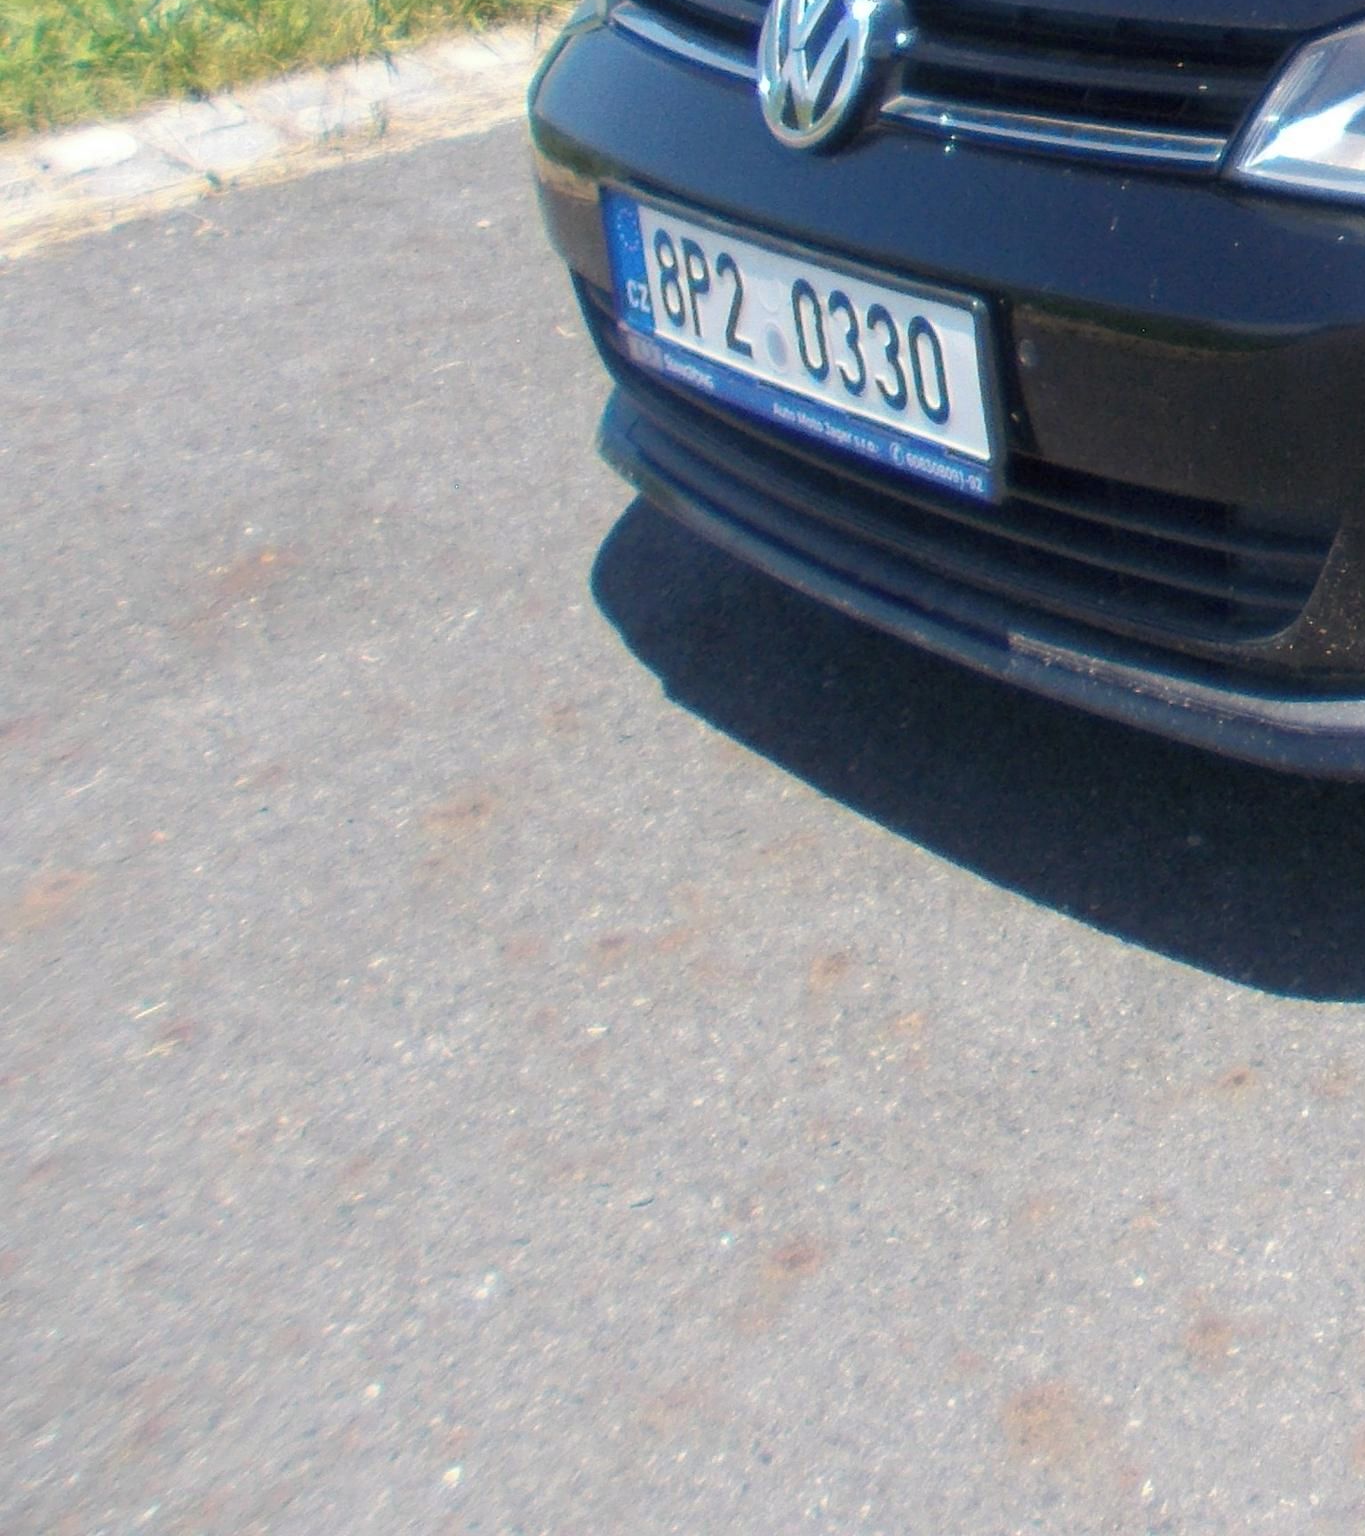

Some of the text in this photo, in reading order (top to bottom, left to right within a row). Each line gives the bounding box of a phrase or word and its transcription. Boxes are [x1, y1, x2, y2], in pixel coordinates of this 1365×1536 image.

[626, 279, 651, 313] CZ
[654, 229, 950, 425] 8P2 0330
